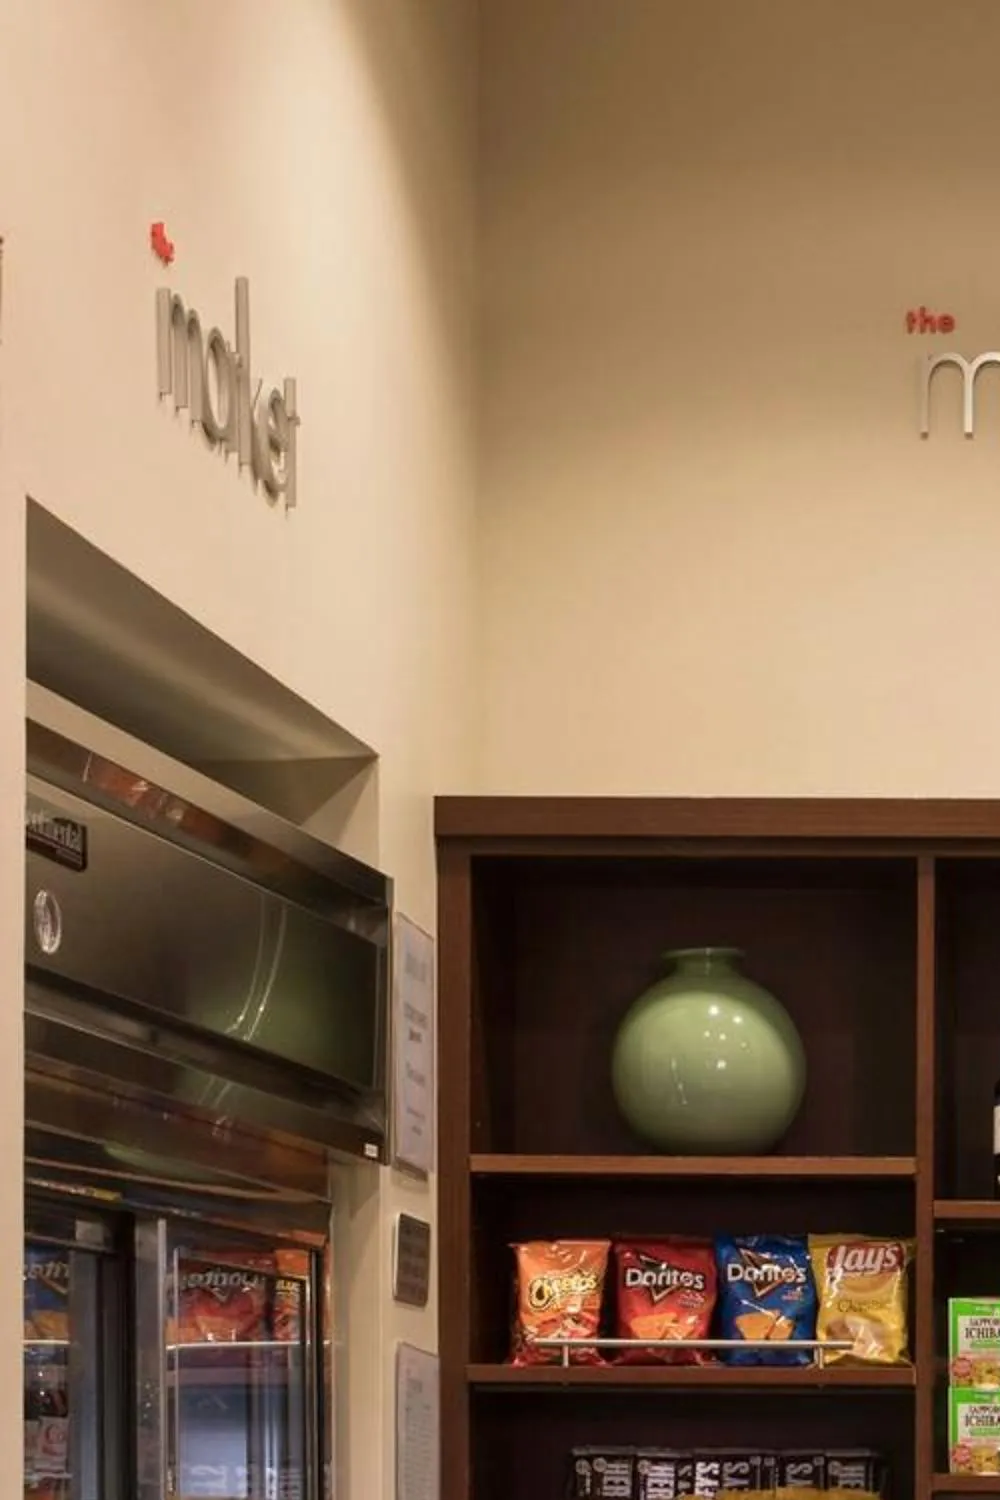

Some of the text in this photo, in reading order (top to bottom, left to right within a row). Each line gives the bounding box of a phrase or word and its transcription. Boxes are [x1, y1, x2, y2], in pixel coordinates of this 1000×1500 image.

[905, 307, 955, 335] the
[625, 1267, 706, 1290] Doritos
[727, 1263, 807, 1284] Doritos
